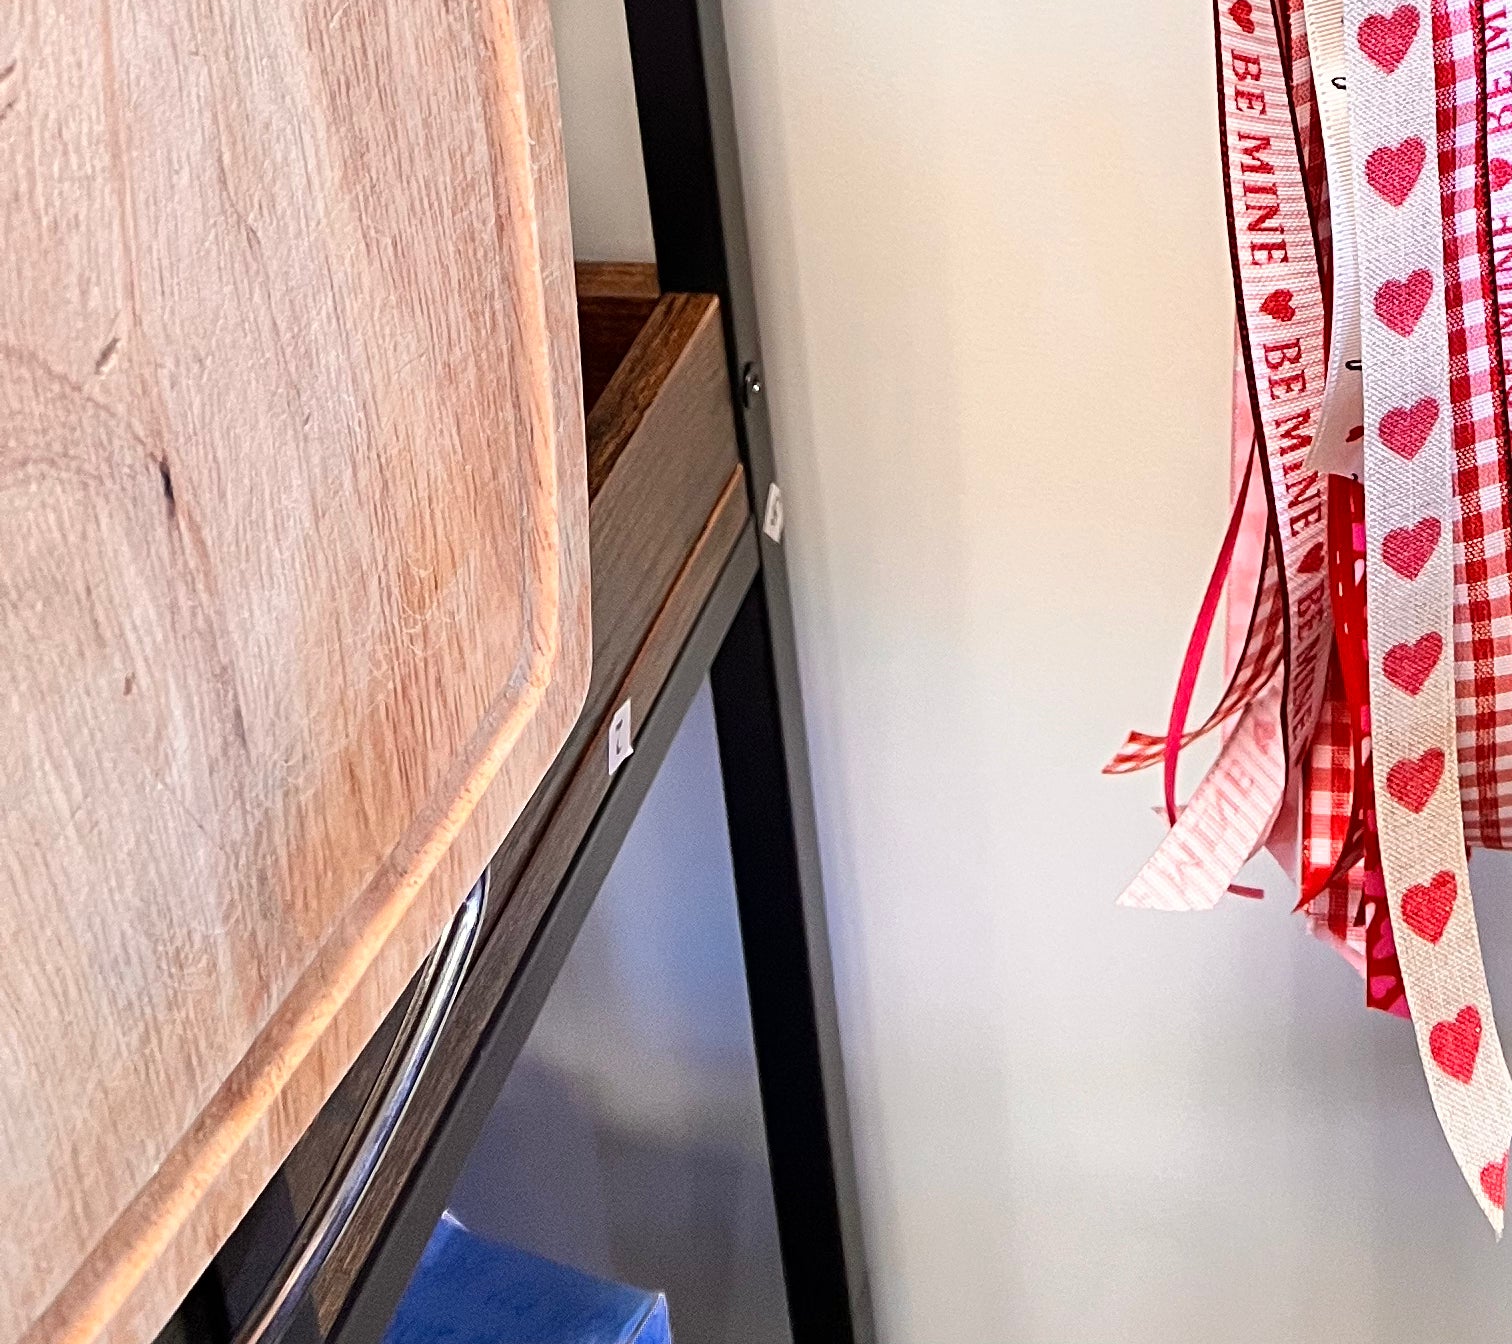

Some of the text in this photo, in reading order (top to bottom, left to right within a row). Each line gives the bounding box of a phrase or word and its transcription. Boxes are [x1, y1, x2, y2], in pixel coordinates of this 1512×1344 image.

[1231, 48, 1267, 116] BE
[1237, 130, 1290, 267] MINE
[1263, 337, 1308, 401] BE
[1274, 408, 1324, 538] MINE
